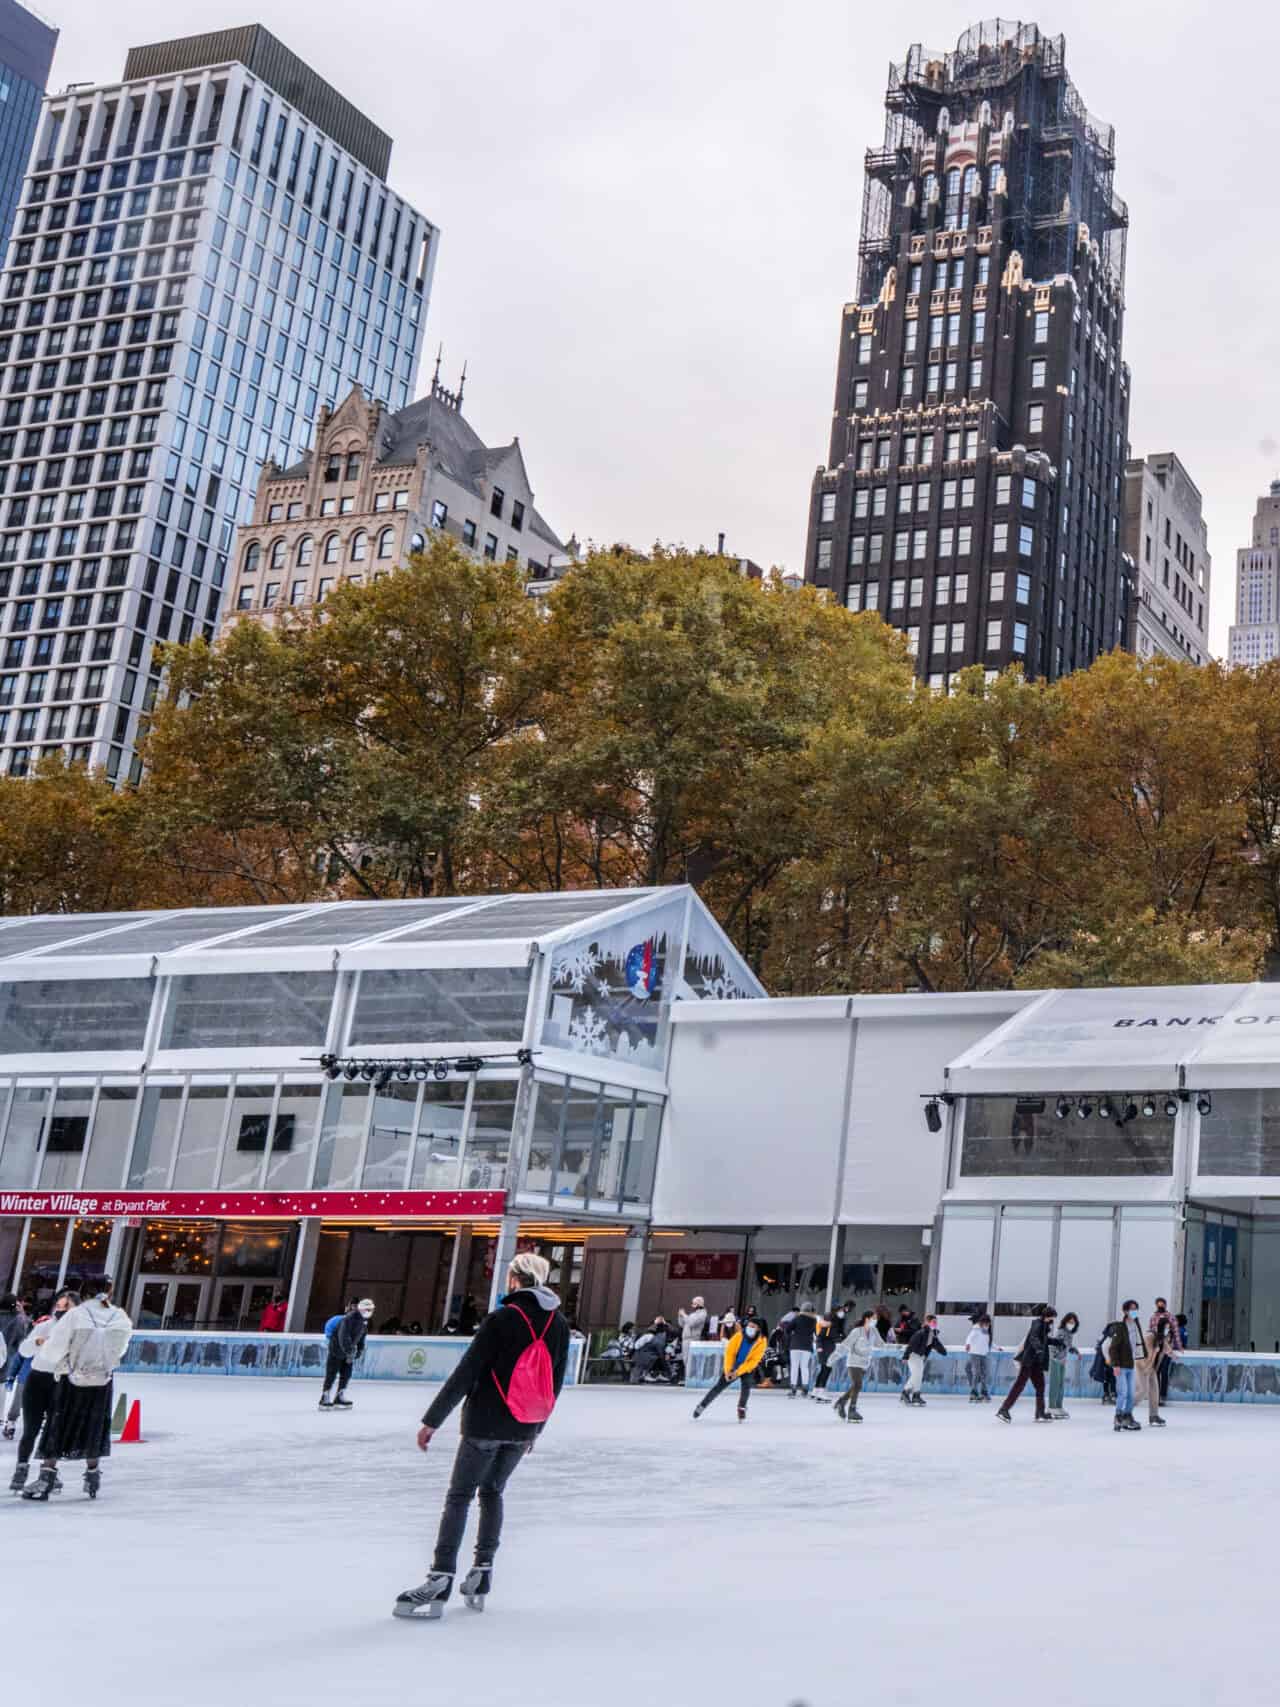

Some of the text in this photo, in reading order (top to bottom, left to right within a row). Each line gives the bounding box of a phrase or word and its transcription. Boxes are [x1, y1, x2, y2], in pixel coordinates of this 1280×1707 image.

[1112, 1015, 1224, 1028] BANK
[0, 1194, 168, 1214] Winter Village at Bryant Park
